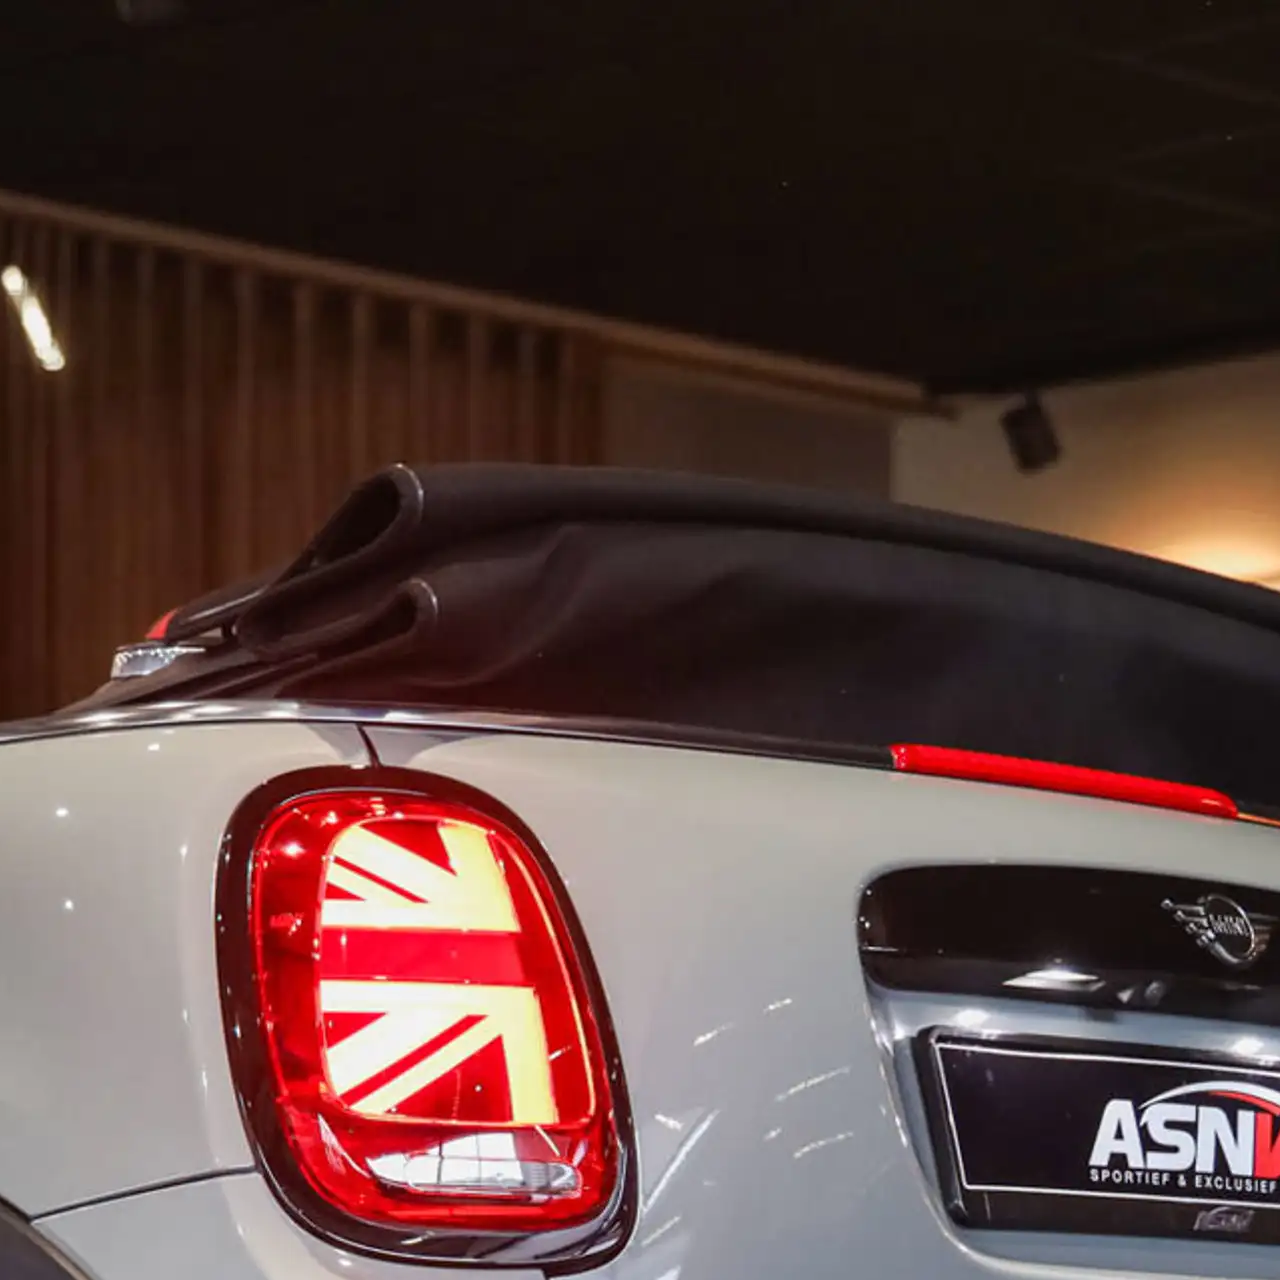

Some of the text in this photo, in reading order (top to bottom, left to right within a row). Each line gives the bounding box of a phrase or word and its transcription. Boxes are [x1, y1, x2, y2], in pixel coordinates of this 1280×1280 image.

[1089, 1167, 1278, 1194] SPORTIEF & EXCLUSIEF
